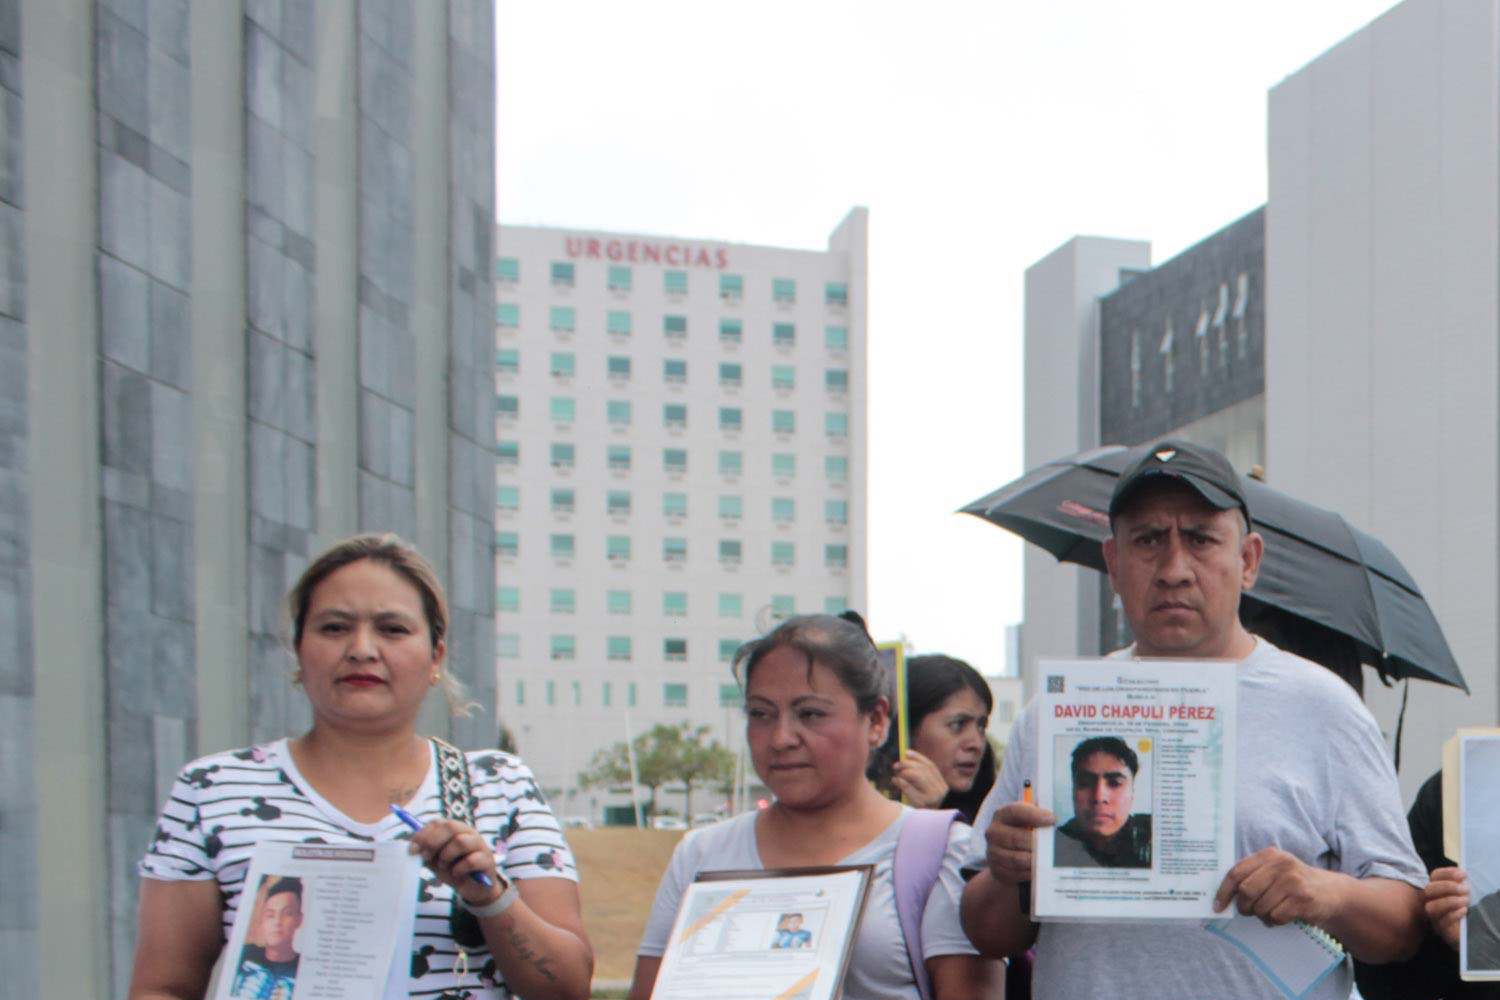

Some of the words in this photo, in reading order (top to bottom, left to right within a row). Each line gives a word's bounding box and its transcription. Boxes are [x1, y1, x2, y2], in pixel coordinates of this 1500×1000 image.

[566, 238, 729, 269] URGENCIAS
[1054, 704, 1097, 718] DAVID
[1101, 704, 1164, 719] CHAPULI
[1169, 702, 1216, 720] PÉREZ
